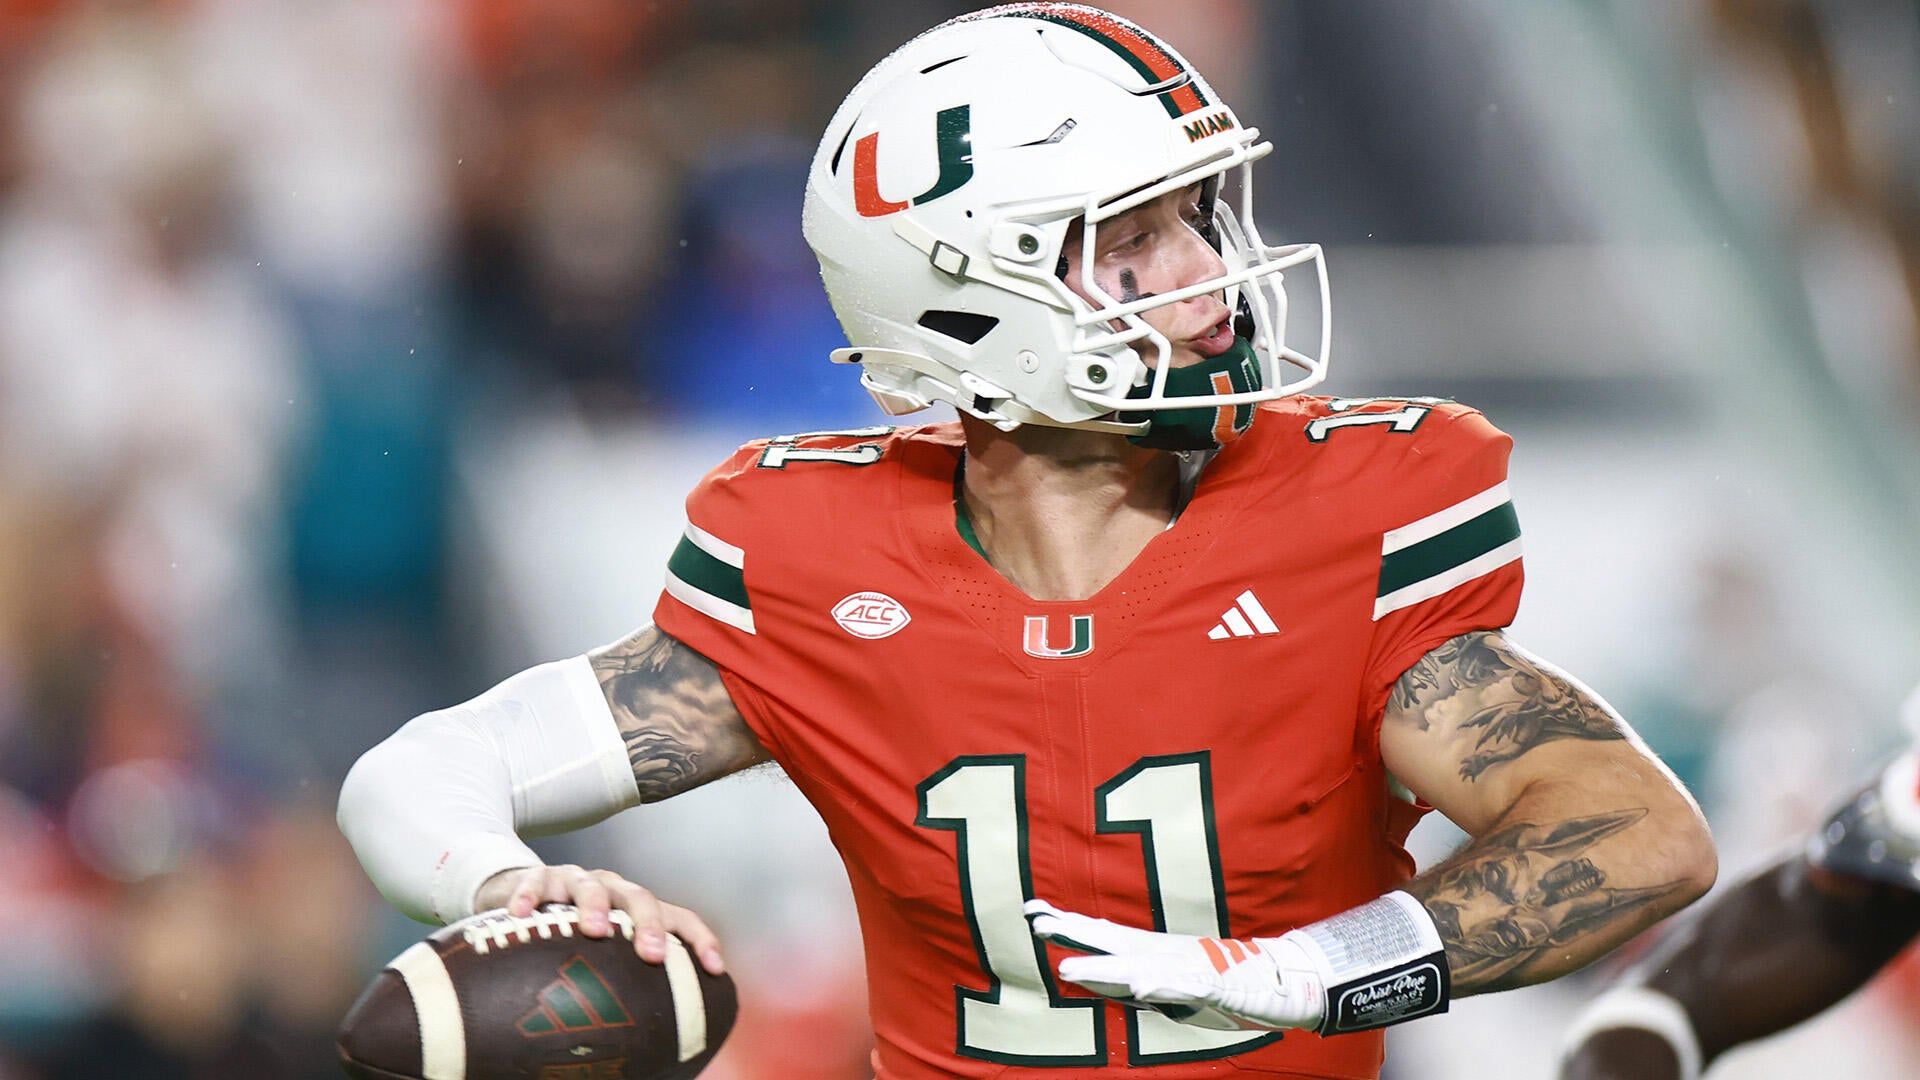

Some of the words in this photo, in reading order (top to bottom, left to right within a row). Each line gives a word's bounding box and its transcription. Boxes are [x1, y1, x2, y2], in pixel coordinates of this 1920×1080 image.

[853, 104, 974, 218] U
[844, 604, 897, 622] ACC
[1023, 614, 1095, 660] U
[914, 749, 1283, 1068] 11
